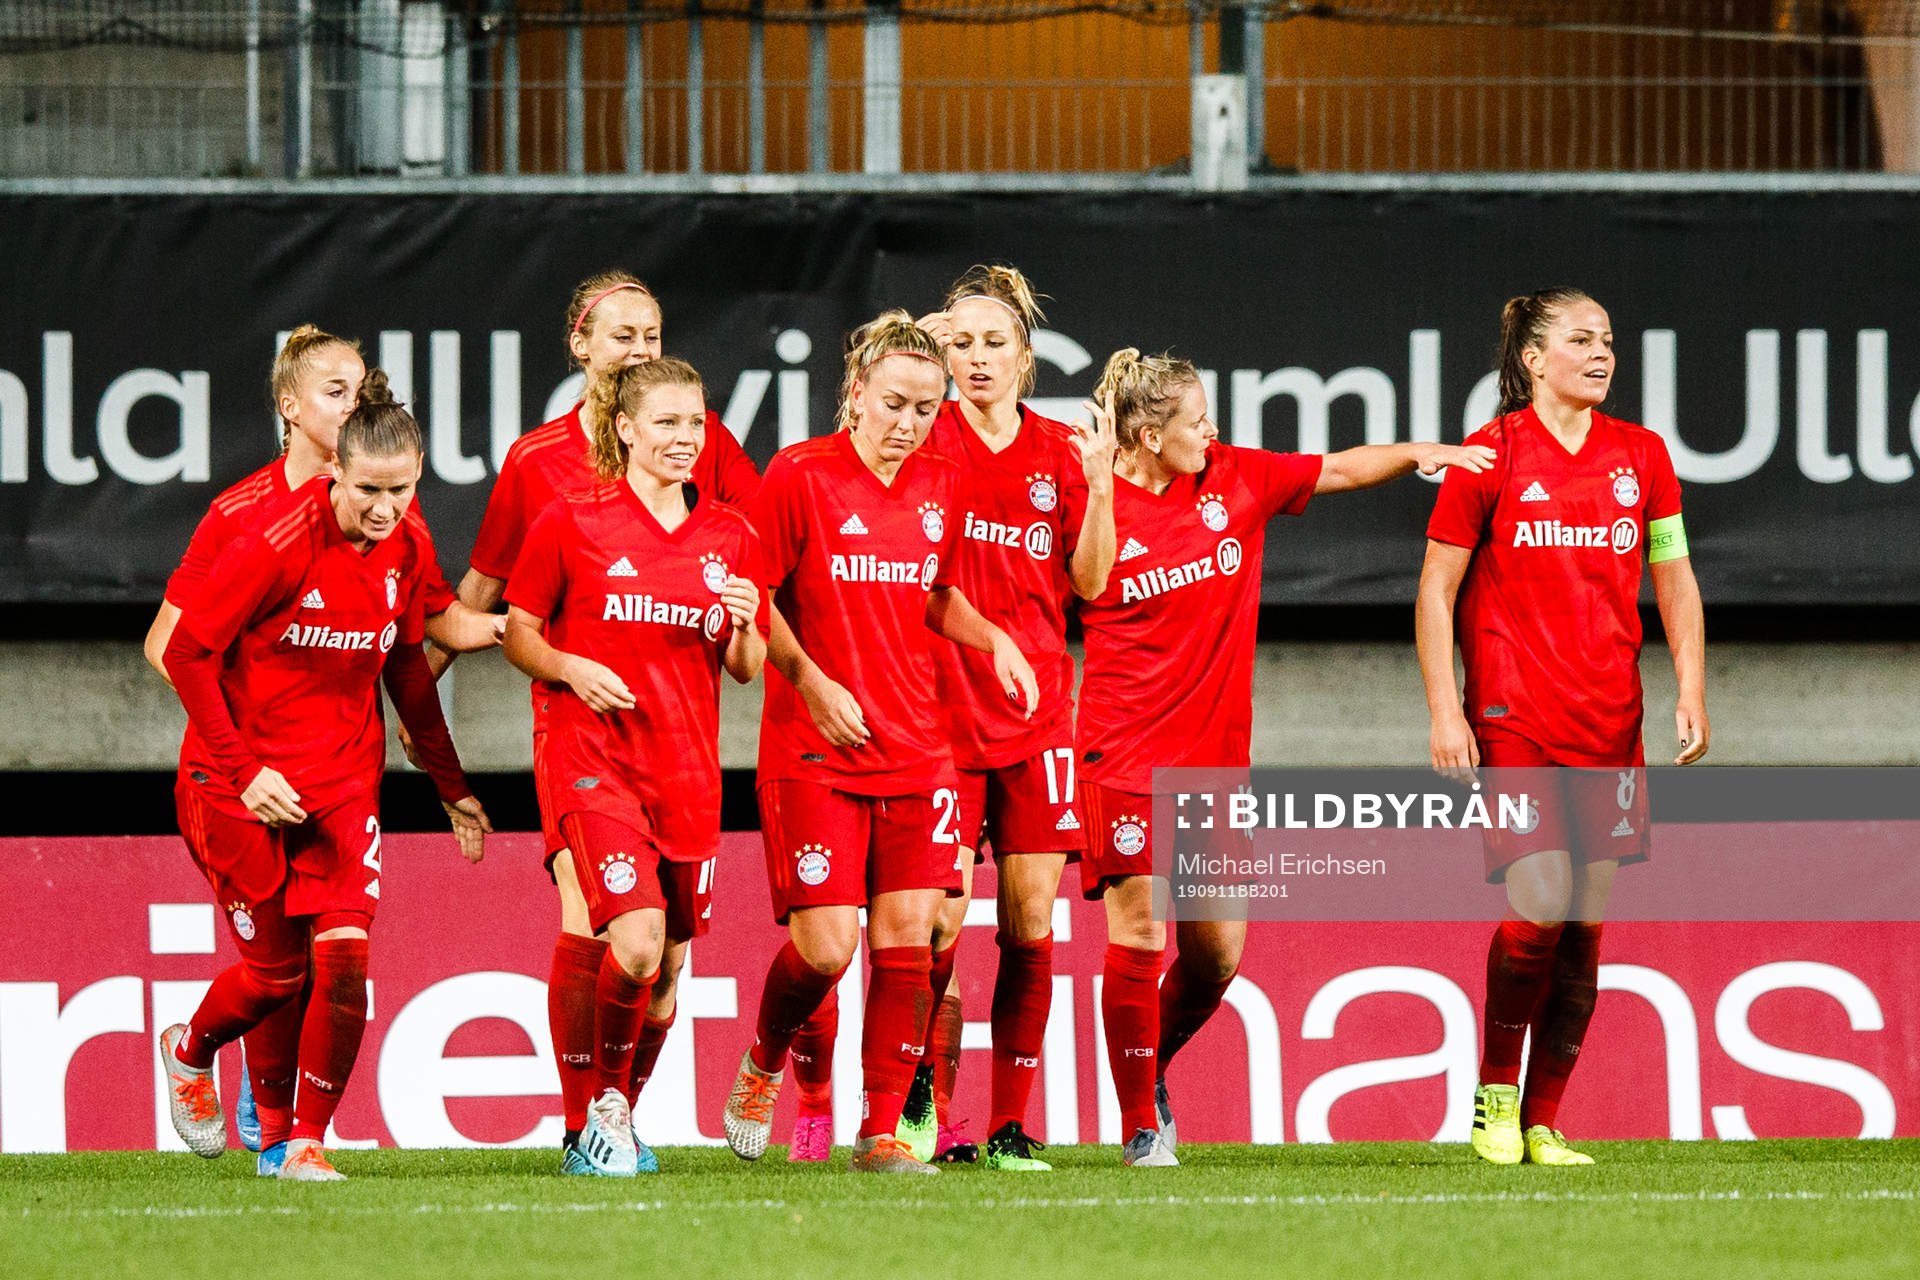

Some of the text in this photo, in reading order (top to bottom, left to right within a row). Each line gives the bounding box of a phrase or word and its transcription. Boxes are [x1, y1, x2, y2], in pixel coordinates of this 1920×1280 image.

[0, 330, 210, 485] la
[1641, 328, 1920, 485] Ull
[964, 511, 1021, 548] ianz
[1513, 521, 1608, 548] Allianz
[831, 554, 920, 584] Allianz
[1121, 555, 1215, 603] Allianz
[602, 593, 702, 629] Allianz
[279, 621, 376, 652] Allianz
[1042, 747, 1075, 804] 17
[562, 1053, 592, 1064] FCB
[1015, 1056, 1039, 1068] FCB
[1124, 1047, 1153, 1058] FCB
